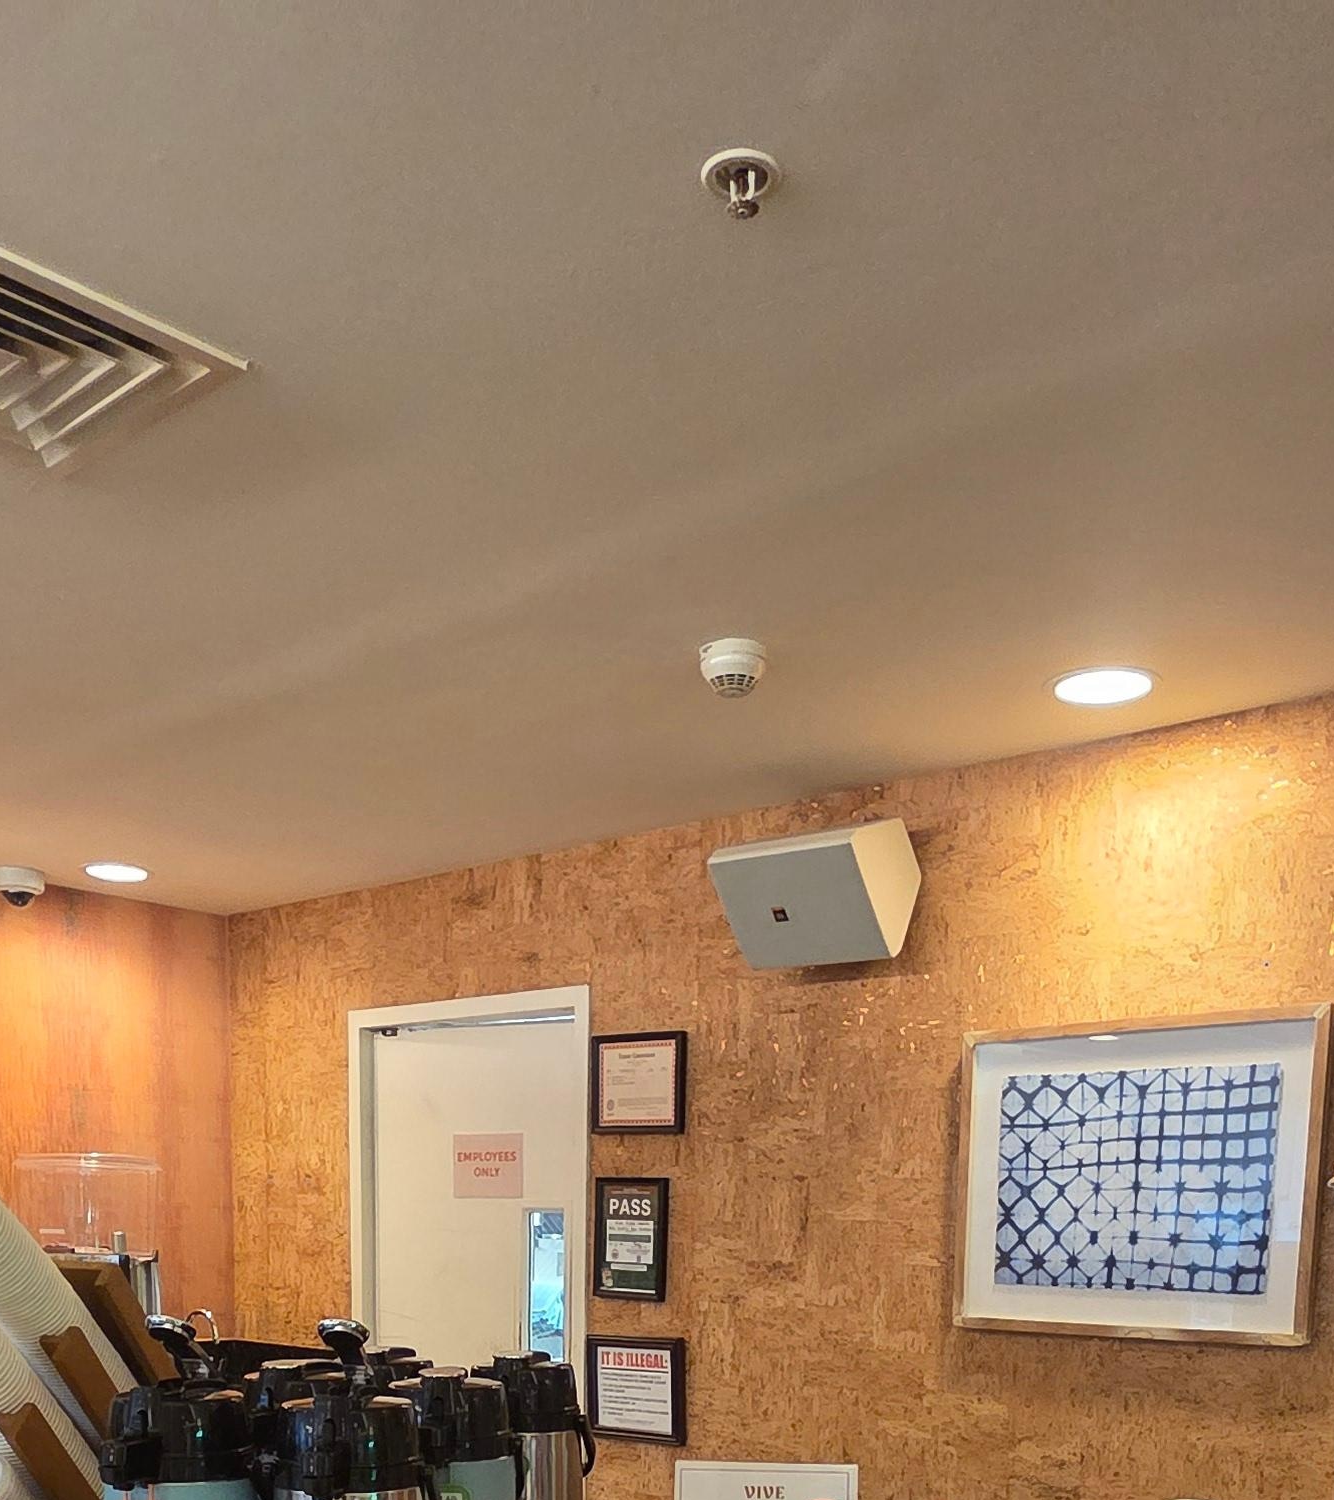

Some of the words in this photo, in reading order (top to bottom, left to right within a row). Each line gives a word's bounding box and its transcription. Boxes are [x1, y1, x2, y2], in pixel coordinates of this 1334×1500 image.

[457, 1151, 517, 1162] EMPLOYEES
[473, 1166, 500, 1177] ONLY
[609, 1198, 651, 1216] PASS
[601, 1351, 611, 1366] IT
[613, 1352, 624, 1366] IS
[626, 1353, 668, 1369] ILLEGAL:
[744, 1486, 785, 1499] VIVE
